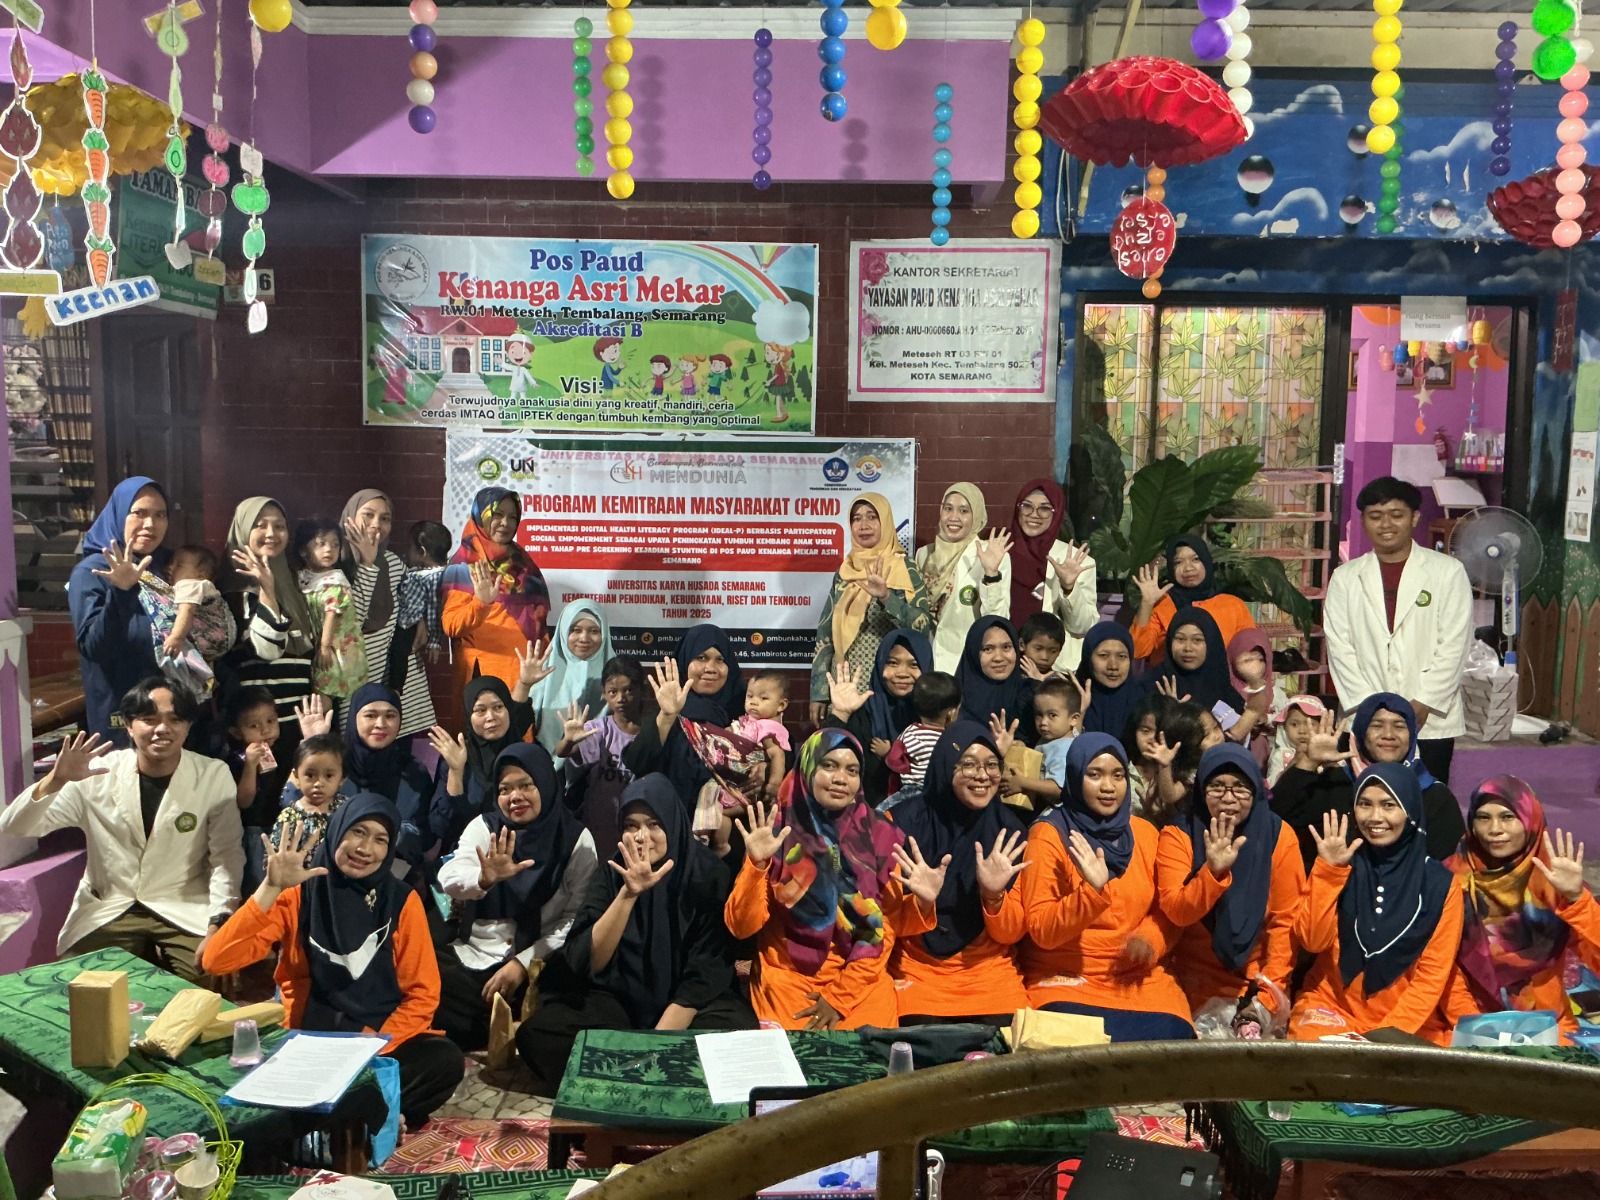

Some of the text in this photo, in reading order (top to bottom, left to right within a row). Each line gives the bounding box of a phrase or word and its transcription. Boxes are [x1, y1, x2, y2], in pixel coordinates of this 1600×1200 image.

[529, 248, 644, 272] Pos Paud
[893, 267, 1020, 277] KANTOR SEKRETARIAT
[259, 273, 272, 291] 6
[437, 271, 726, 307] Kenanga Asri Mekar
[868, 288, 909, 307] YAYASAN
[911, 288, 935, 307] PAUD
[440, 305, 726, 325] RW.01 Meteseh, Tembalang, Semarang
[532, 321, 643, 338] Akreditasi B
[872, 326, 900, 335] NOMOR
[1414, 321, 1441, 329] bersama
[869, 361, 887, 369] Kel.
[889, 361, 929, 369] Meteseh
[932, 361, 952, 369] Kec.
[911, 373, 993, 381] KOTA SEMARANG
[560, 376, 604, 394] Visi:
[449, 396, 734, 411] Terwujudnya anak usia dini yang kreatif, mandiri, ceria
[421, 409, 760, 426] cerdas IMTAQ dan IPTEK dengan tumbuh kembang yang optimal
[650, 469, 748, 484] MENDUNIA
[523, 494, 841, 516] PROGRAM KEMITRAAN MASYARAKAT (PKM)
[526, 525, 579, 533] IMPLEMENTASI
[581, 525, 608, 533] DIGITAL
[638, 526, 671, 534] LITERACY
[530, 535, 556, 543] SOCIAL
[615, 536, 646, 544] SEBAGAI
[672, 537, 722, 545] PENINGKATAN
[593, 546, 633, 554] SCREENING
[672, 547, 708, 555] STUNTING
[758, 548, 792, 556] KENANGA
[662, 557, 702, 565] SEMARANG
[607, 579, 766, 592] UNIVERSITAS KARYA HUSADA SEMARANG
[619, 594, 669, 606] PENDIDIKAN,
[671, 595, 725, 606] KEBUDAYAAN,
[726, 595, 749, 605] RISET
[750, 595, 767, 605] DAN
[769, 596, 811, 606] TEKNOLOGI
[662, 608, 712, 619] TAHUN 2025
